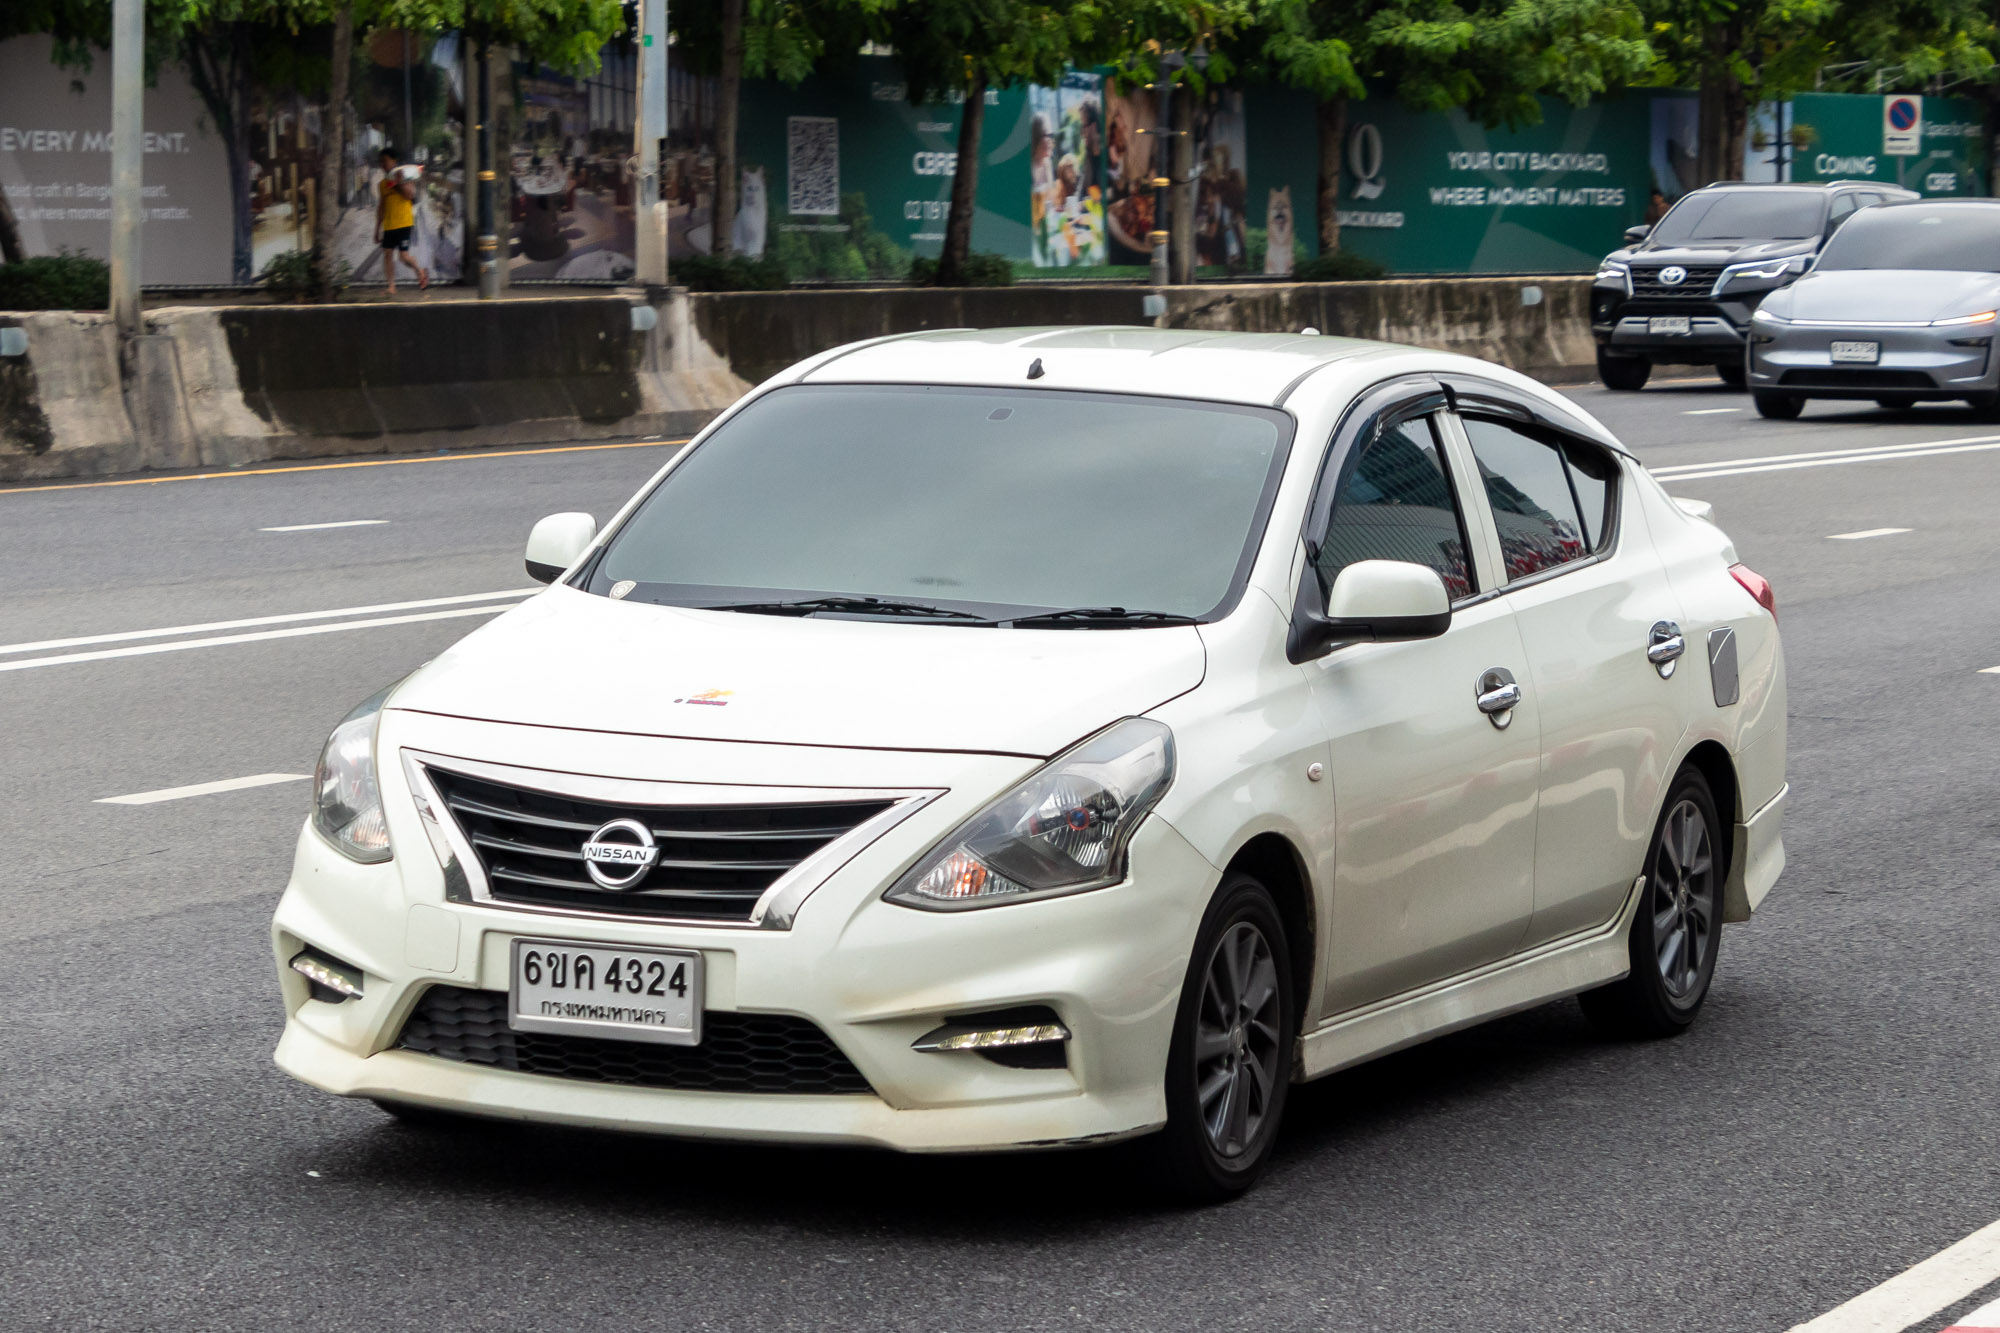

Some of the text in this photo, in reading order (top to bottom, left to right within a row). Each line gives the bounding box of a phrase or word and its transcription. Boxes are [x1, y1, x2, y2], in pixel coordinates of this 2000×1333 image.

[1, 127, 190, 153] EVERY MOENT.
[912, 151, 959, 176] CBRE
[1350, 123, 1385, 200] Q
[1447, 151, 1610, 175] YOUR CITY BACKYARD,
[1430, 187, 1625, 206] WHERE MOMENT MATTERS
[587, 846, 648, 861] NISSAN
[523, 950, 688, 999] 6ขค 4324
[541, 1000, 667, 1025] กรุงเทพมหานคร
